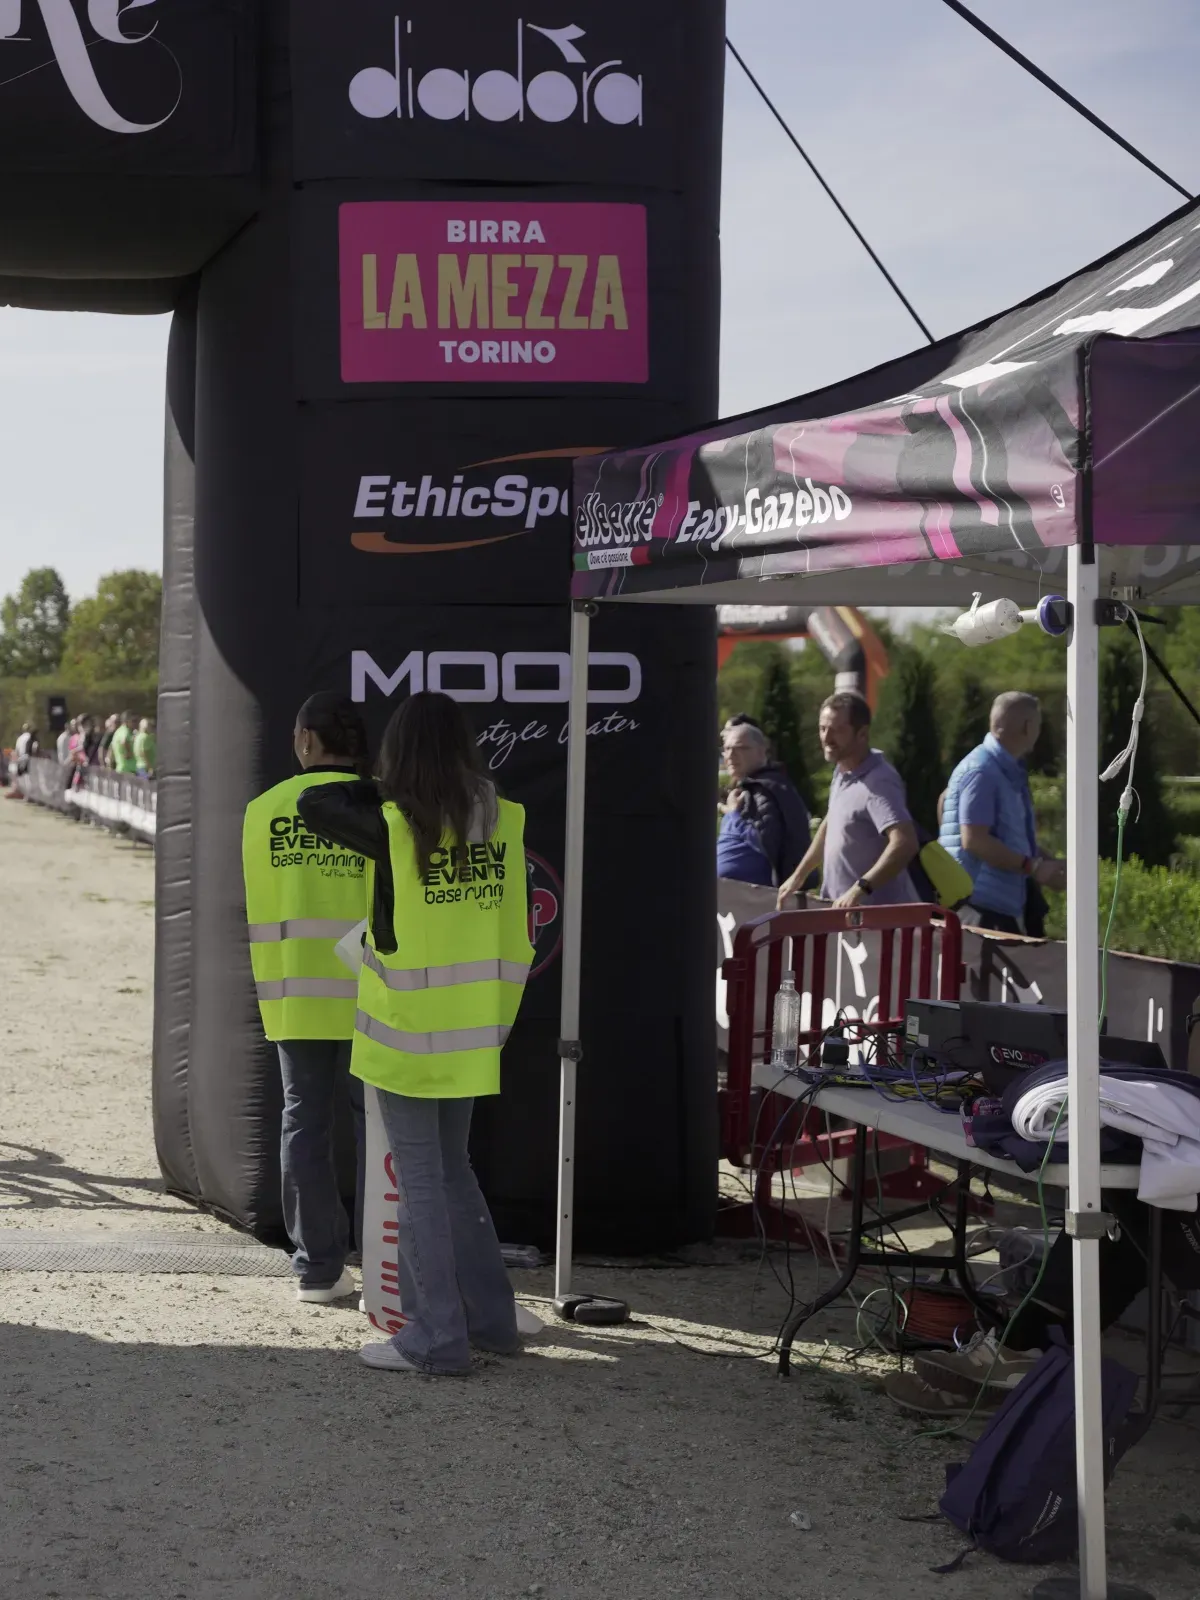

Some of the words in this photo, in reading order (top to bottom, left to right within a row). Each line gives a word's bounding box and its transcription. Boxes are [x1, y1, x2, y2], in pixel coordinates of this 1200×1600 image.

[348, 15, 644, 126] diadora
[446, 219, 547, 244] BIRRA
[361, 252, 428, 330] LA
[436, 253, 630, 331] MEZZA
[439, 340, 557, 365] TORINO
[352, 474, 569, 529] EthicSp
[269, 833, 347, 852] EVEN
[271, 851, 304, 868] base
[306, 853, 366, 873] running
[424, 886, 462, 905] base
